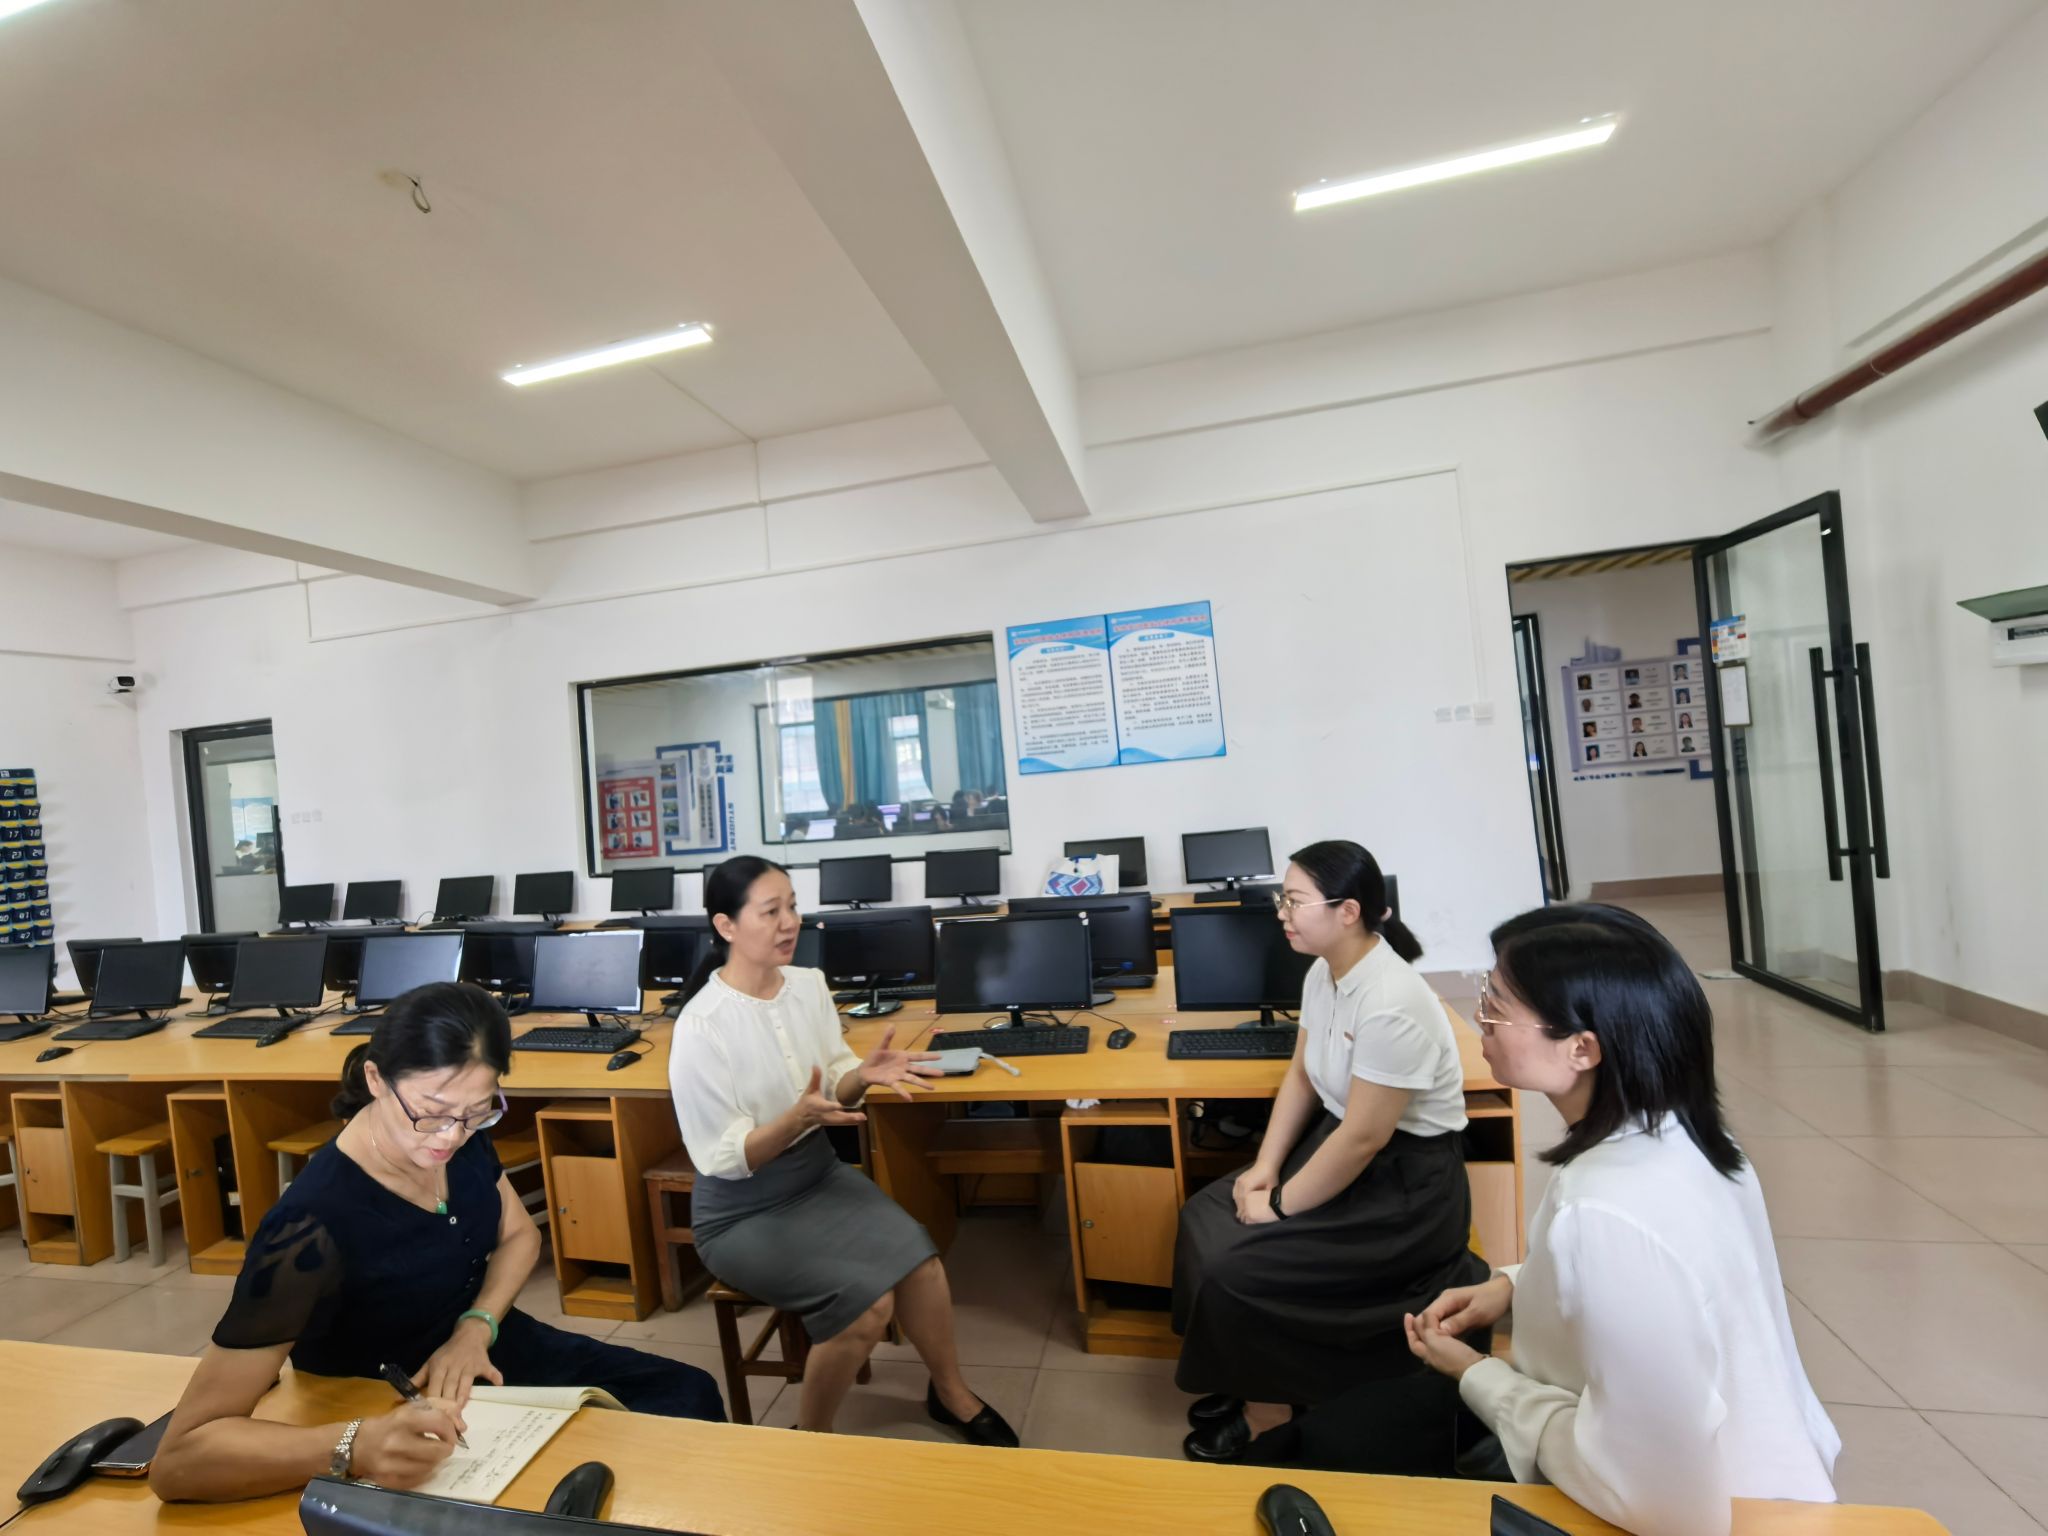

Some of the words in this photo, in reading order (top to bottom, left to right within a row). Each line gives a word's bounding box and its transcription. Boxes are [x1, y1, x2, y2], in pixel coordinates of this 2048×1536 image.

[7, 810, 17, 818] 11
[728, 802, 736, 851] STUDENT
[9, 830, 20, 838] 17
